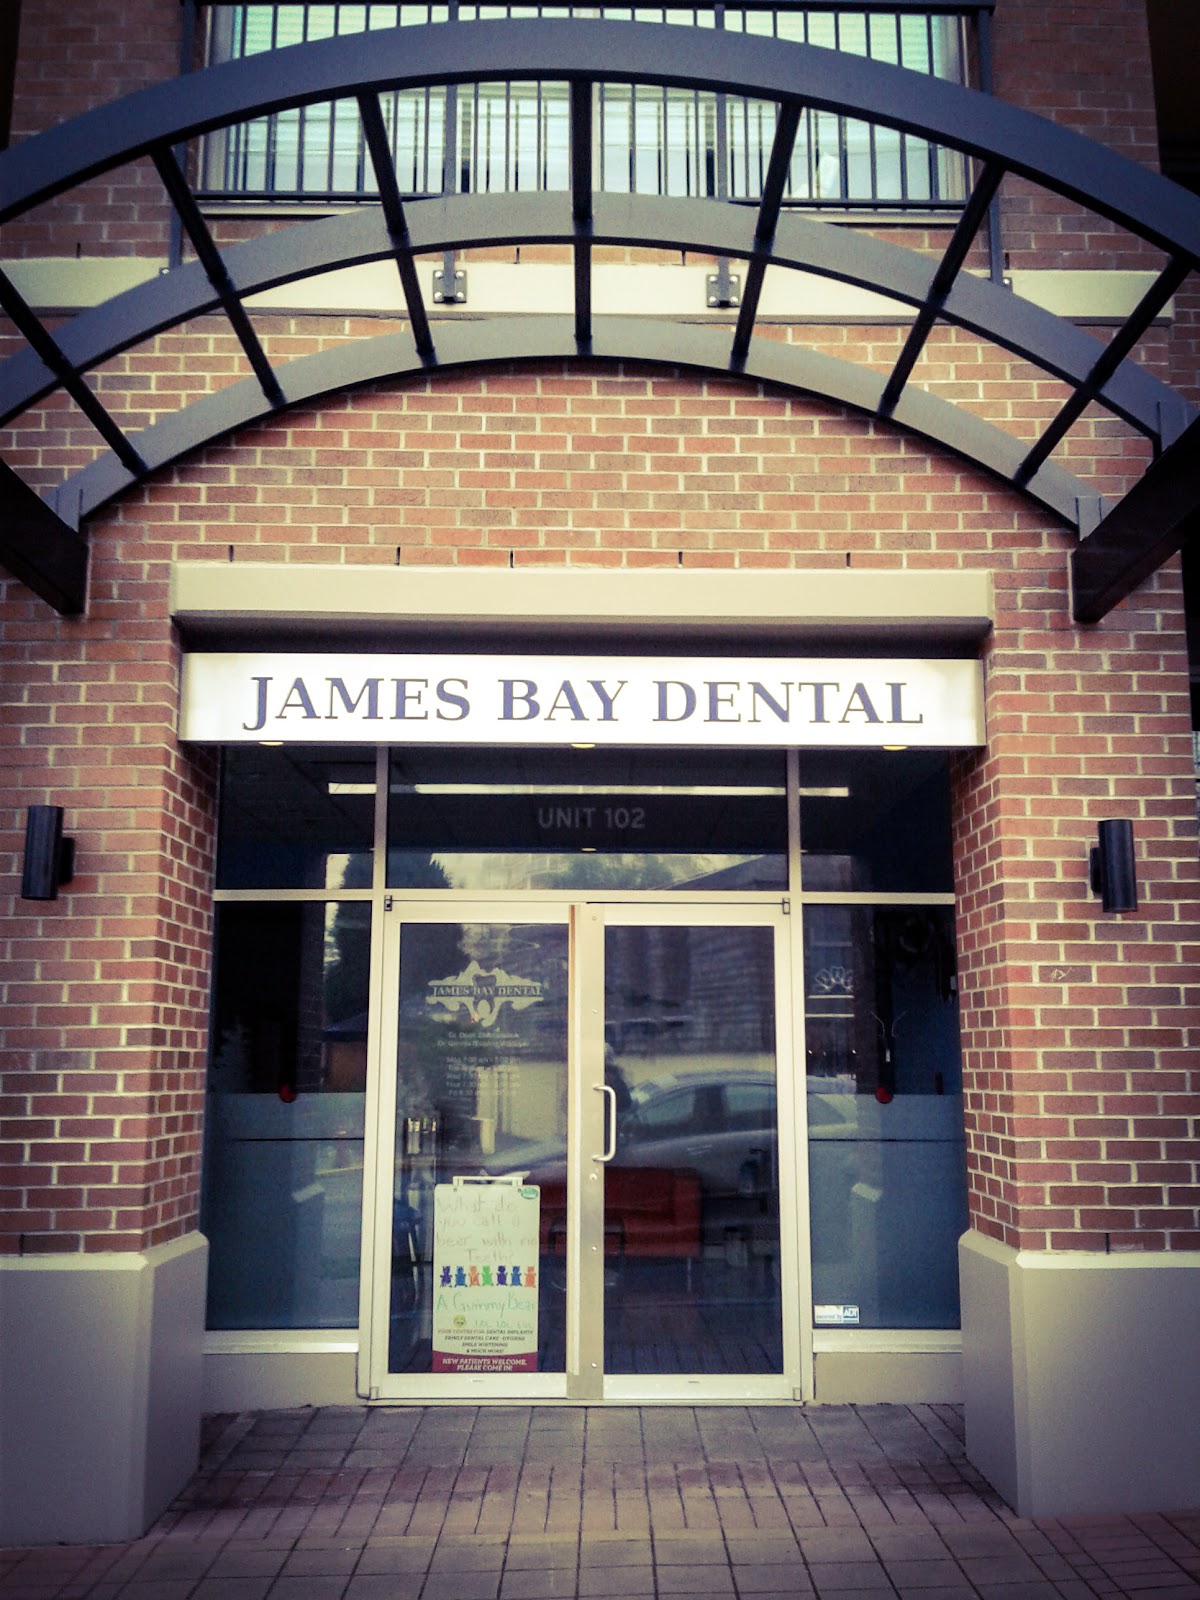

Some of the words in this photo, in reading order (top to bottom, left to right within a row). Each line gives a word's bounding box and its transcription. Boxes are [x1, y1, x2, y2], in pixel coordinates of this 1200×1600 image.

[242, 677, 471, 731] JAMES
[497, 679, 628, 721] BAY
[652, 681, 923, 724] DENTAL
[538, 807, 596, 829] UNIT
[605, 807, 645, 829] 102
[433, 986, 469, 997] JAMES
[473, 986, 494, 995] BAY
[499, 986, 541, 996] DENTAL
[437, 1294, 448, 1311] A
